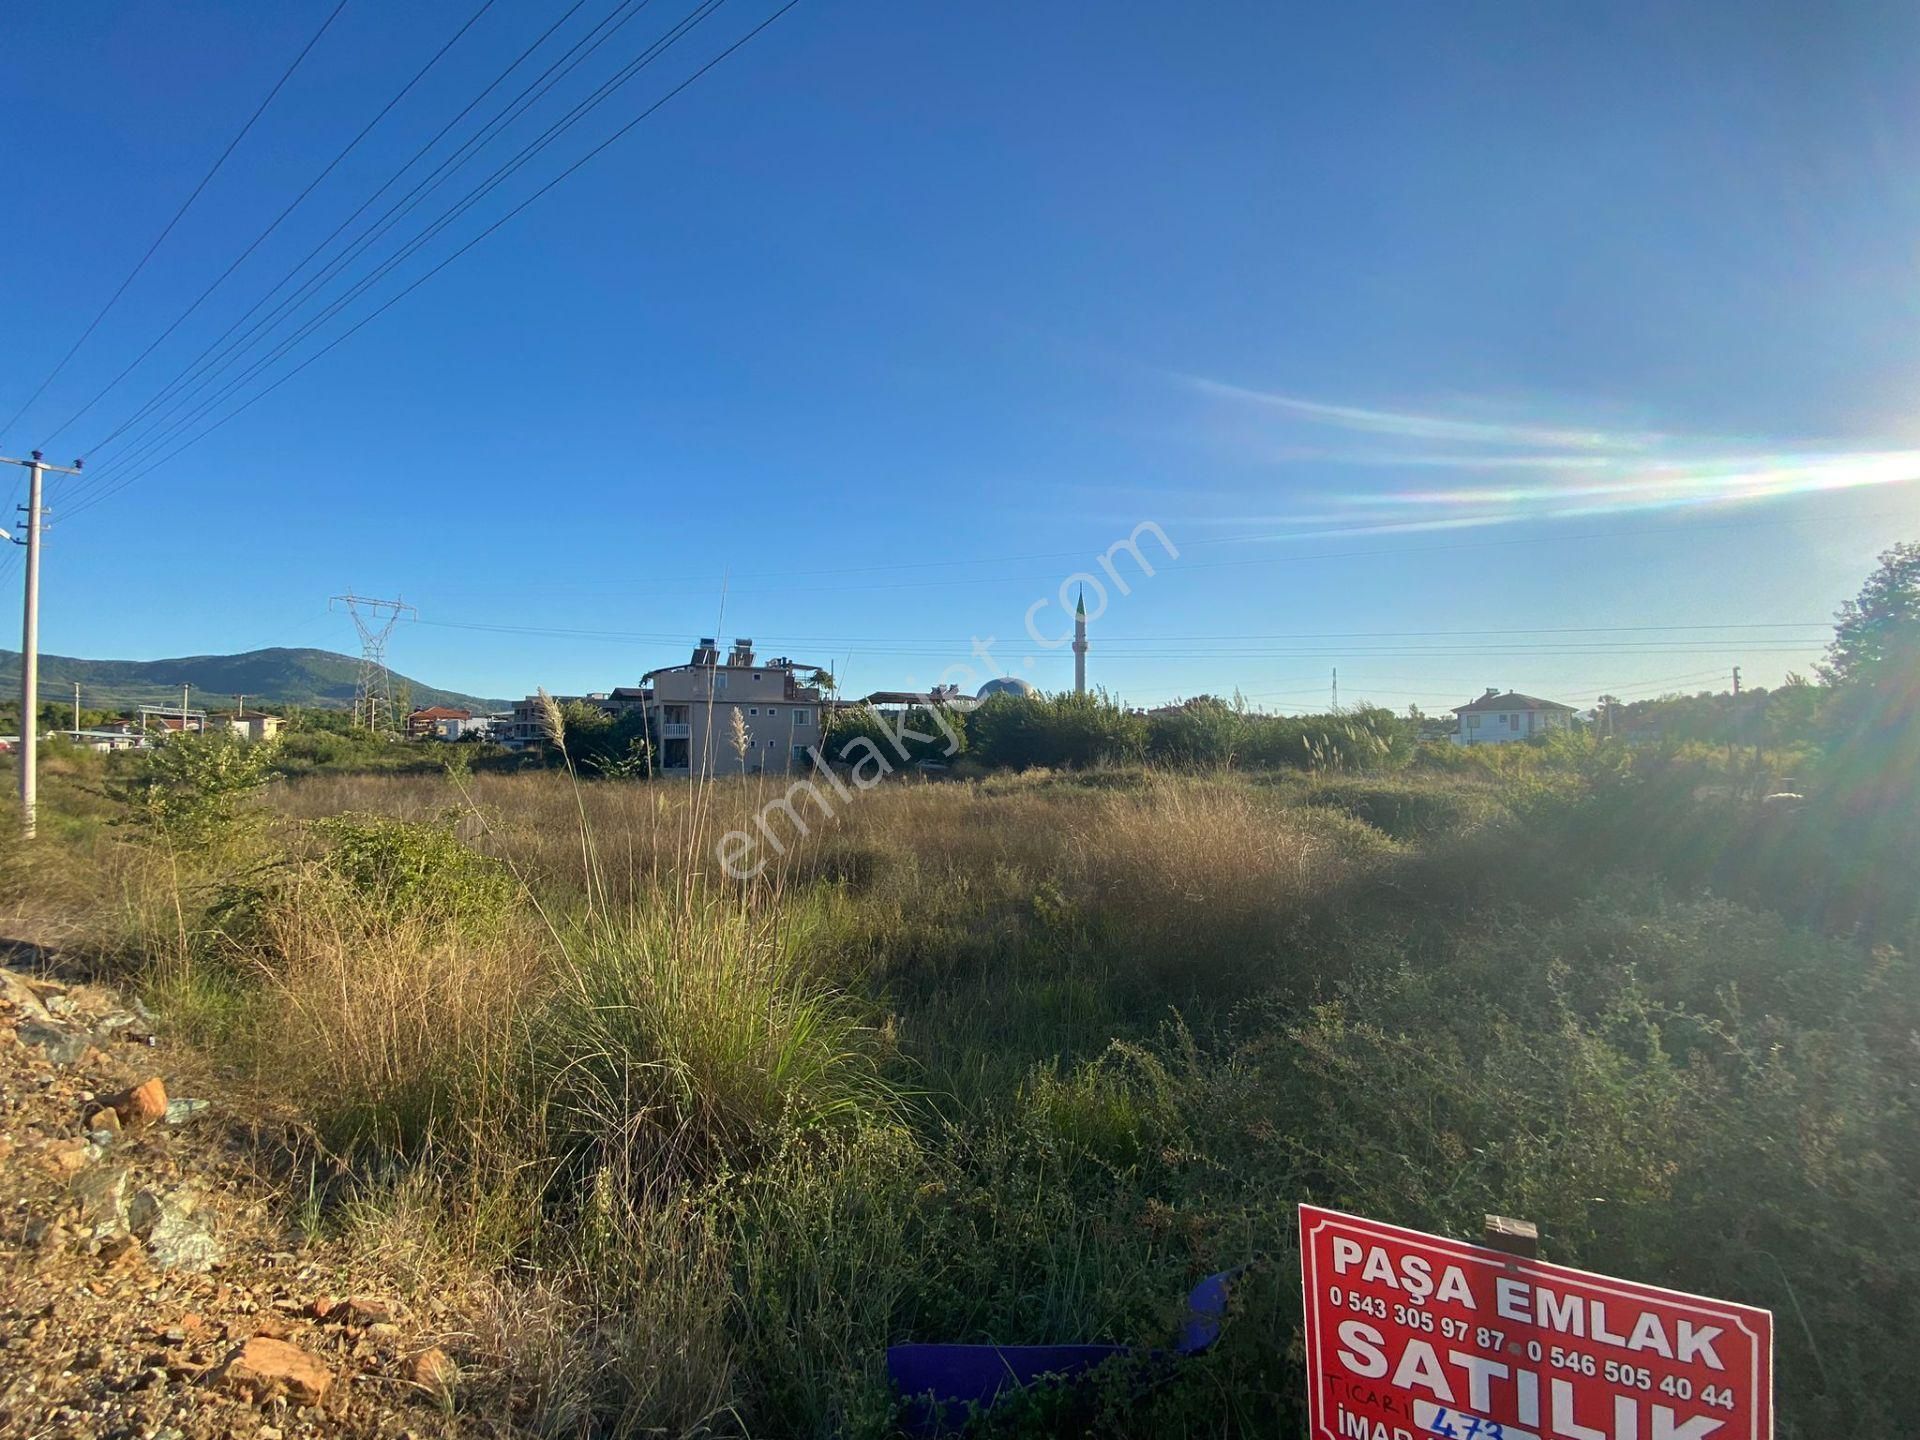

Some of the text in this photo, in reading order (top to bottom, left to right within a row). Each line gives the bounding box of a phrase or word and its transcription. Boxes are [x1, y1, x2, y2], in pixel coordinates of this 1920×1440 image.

[1329, 1286, 1736, 1411] 0 543 305 97 87 0 546 505 40 44
[1332, 1235, 1726, 1371] PAŞA EMLAK
[1336, 1319, 1727, 1440] SATILIK
